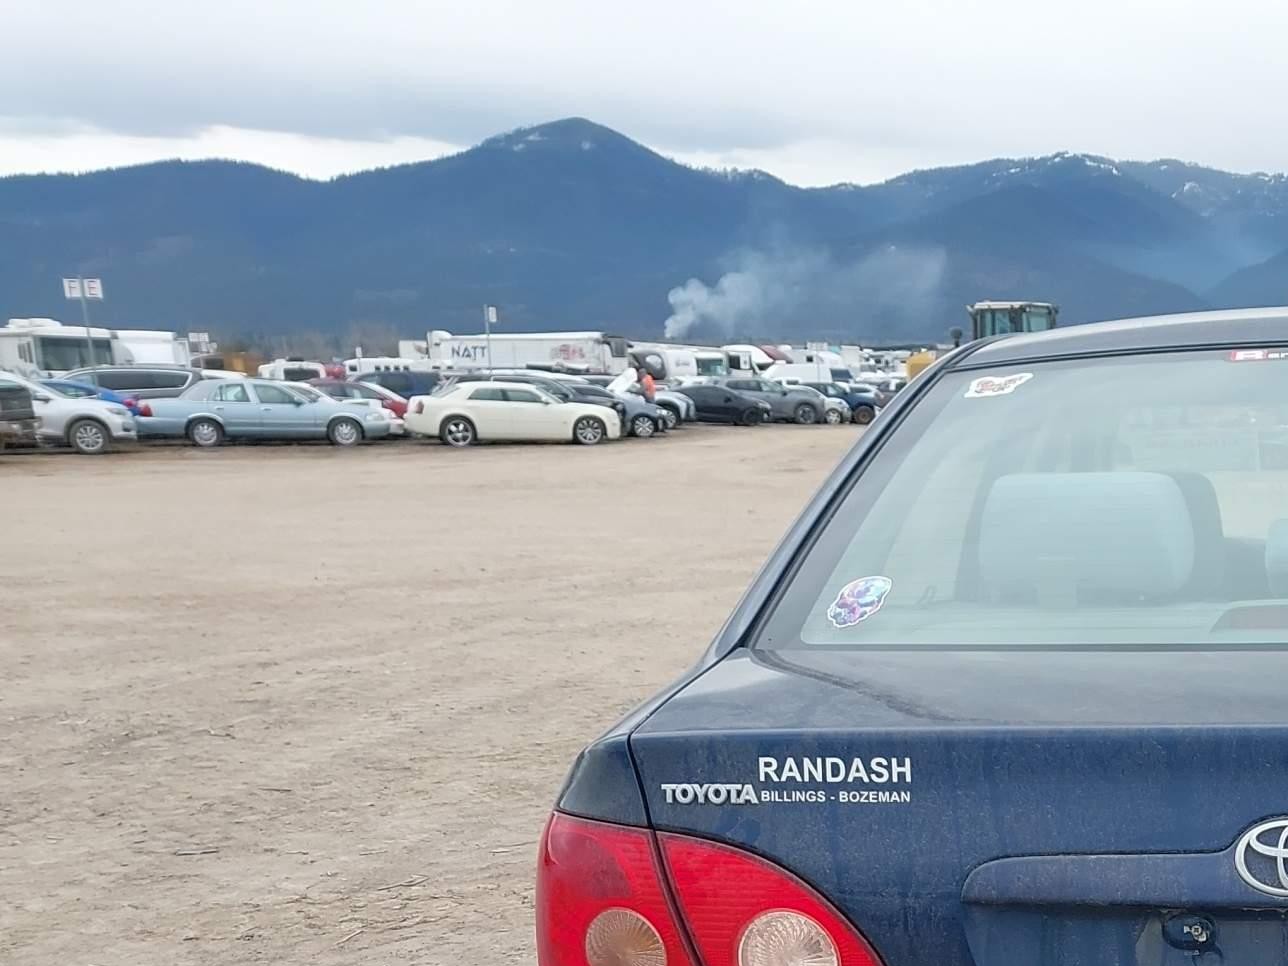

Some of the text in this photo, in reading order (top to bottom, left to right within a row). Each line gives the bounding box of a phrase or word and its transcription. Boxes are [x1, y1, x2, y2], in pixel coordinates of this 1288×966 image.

[758, 756, 912, 782] RANDASH
[661, 783, 759, 804] TOYOTA
[761, 790, 827, 803] BILLINGS
[839, 790, 911, 803] BOZEMAN
